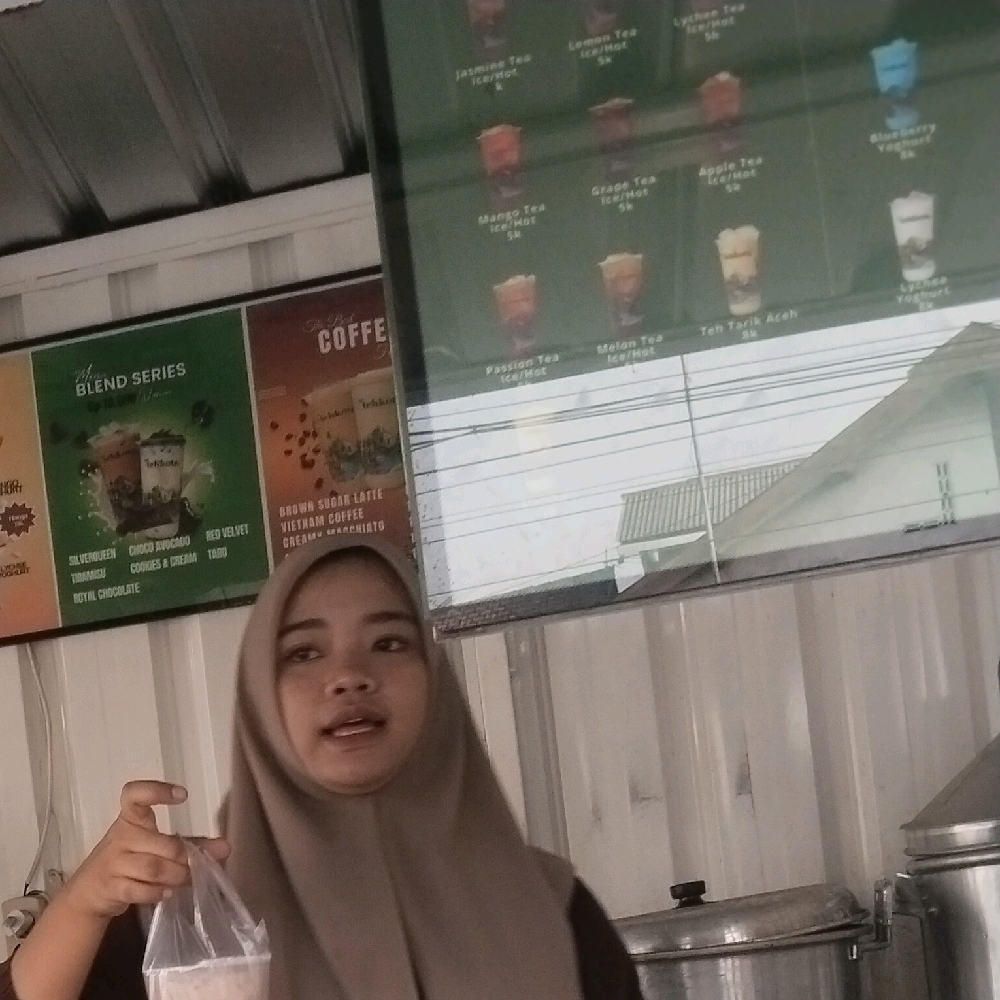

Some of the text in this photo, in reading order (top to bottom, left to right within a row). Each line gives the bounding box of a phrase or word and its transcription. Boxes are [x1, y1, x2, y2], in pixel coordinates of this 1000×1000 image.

[723, 3, 745, 14] Tea
[614, 28, 637, 39] Tea
[509, 54, 531, 66] Tea
[740, 157, 763, 168] Tea
[634, 175, 657, 187] Tea
[478, 204, 545, 225] Mango Tea
[766, 310, 799, 324] Aceh
[597, 334, 664, 355] Melon Tea
[537, 353, 559, 364] Tea
[75, 375, 128, 397] BLEND
[132, 362, 187, 385] SERIES
[279, 488, 383, 518] BROWN SUGAR LATTE
[280, 508, 364, 534] VIETNAM COFFEE
[206, 523, 250, 542] RED VELVET
[128, 541, 155, 557] CHOCO
[130, 559, 162, 574] COOKIES
[169, 552, 198, 568] CREAM
[73, 582, 140, 604] ROYAL CHOCOLATE
